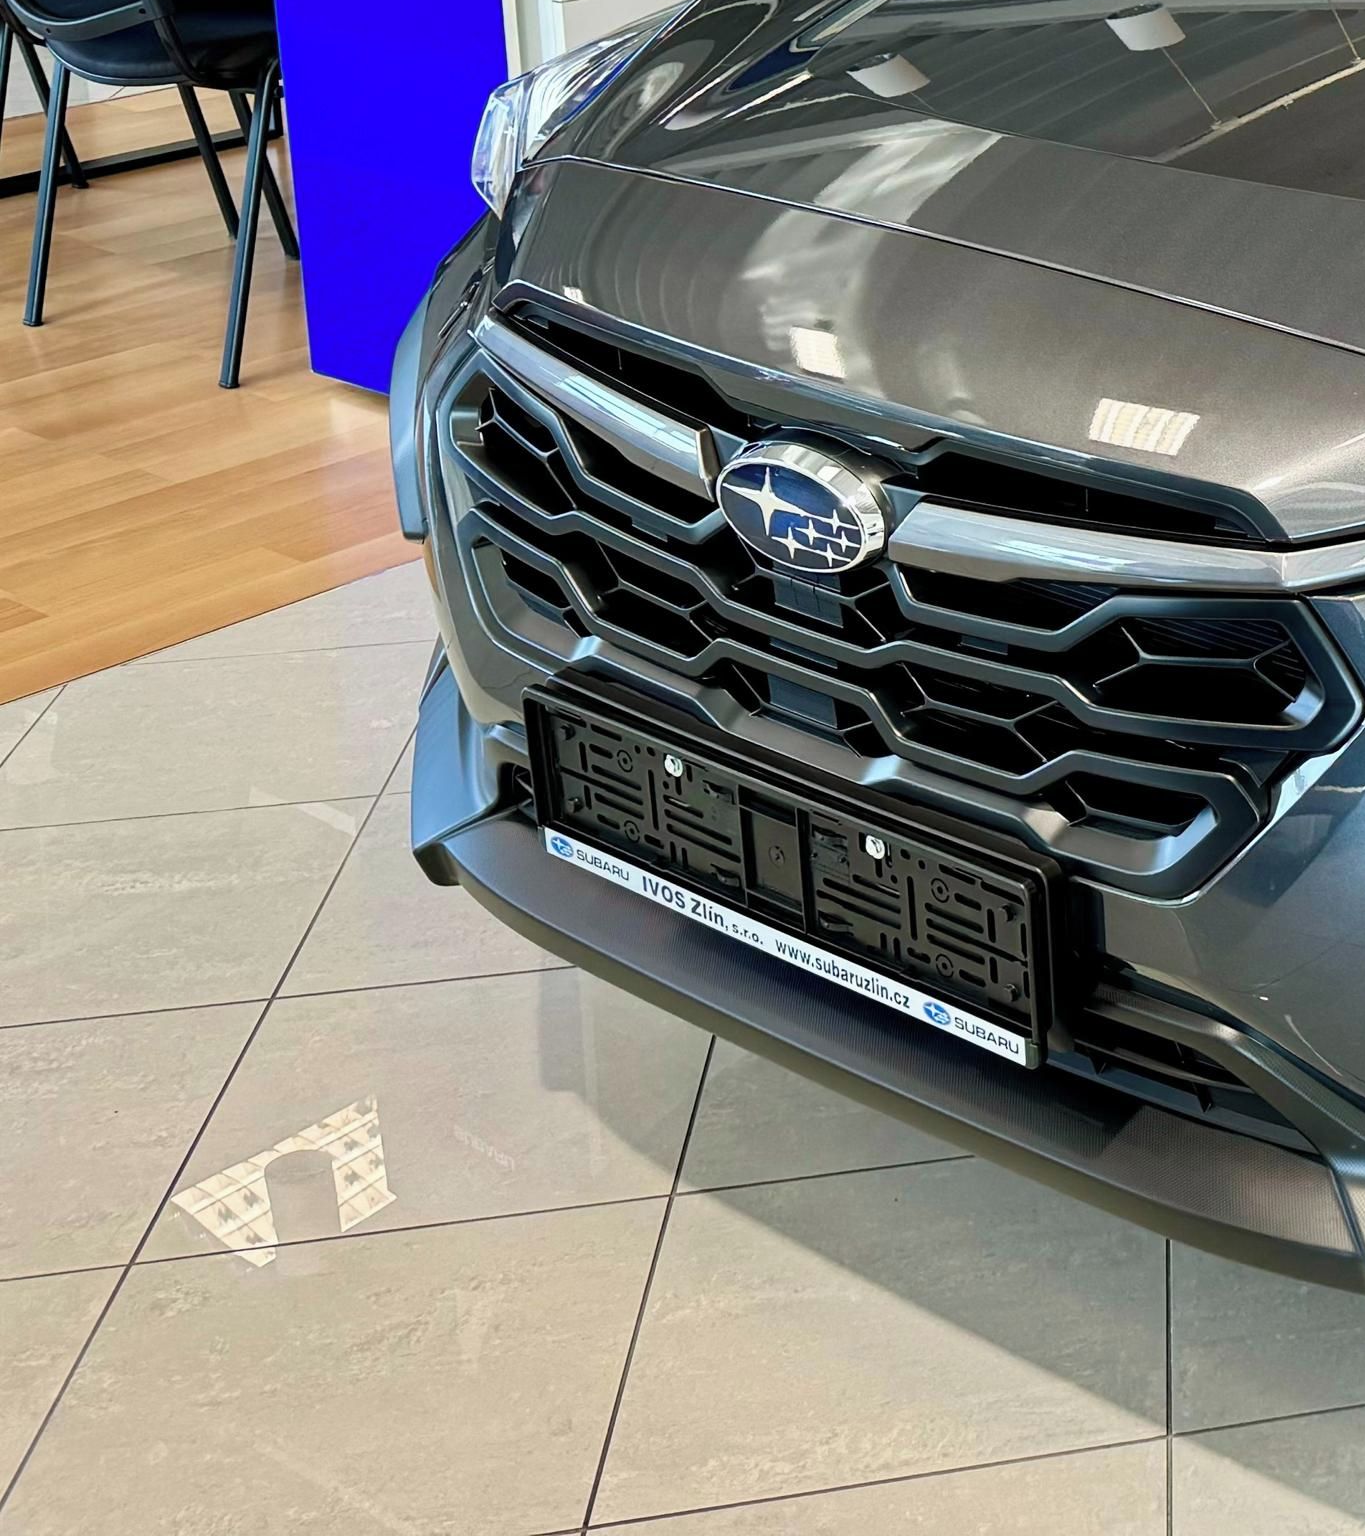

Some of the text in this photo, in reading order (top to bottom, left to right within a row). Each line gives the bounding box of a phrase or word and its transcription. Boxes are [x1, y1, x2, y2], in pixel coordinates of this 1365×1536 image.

[576, 849, 630, 882] SUBARU
[642, 875, 686, 909] IVOS
[732, 922, 764, 946] s.r.o.
[775, 938, 911, 1010] www.subaruzlin.cz
[954, 1016, 1020, 1054] SUBARU
